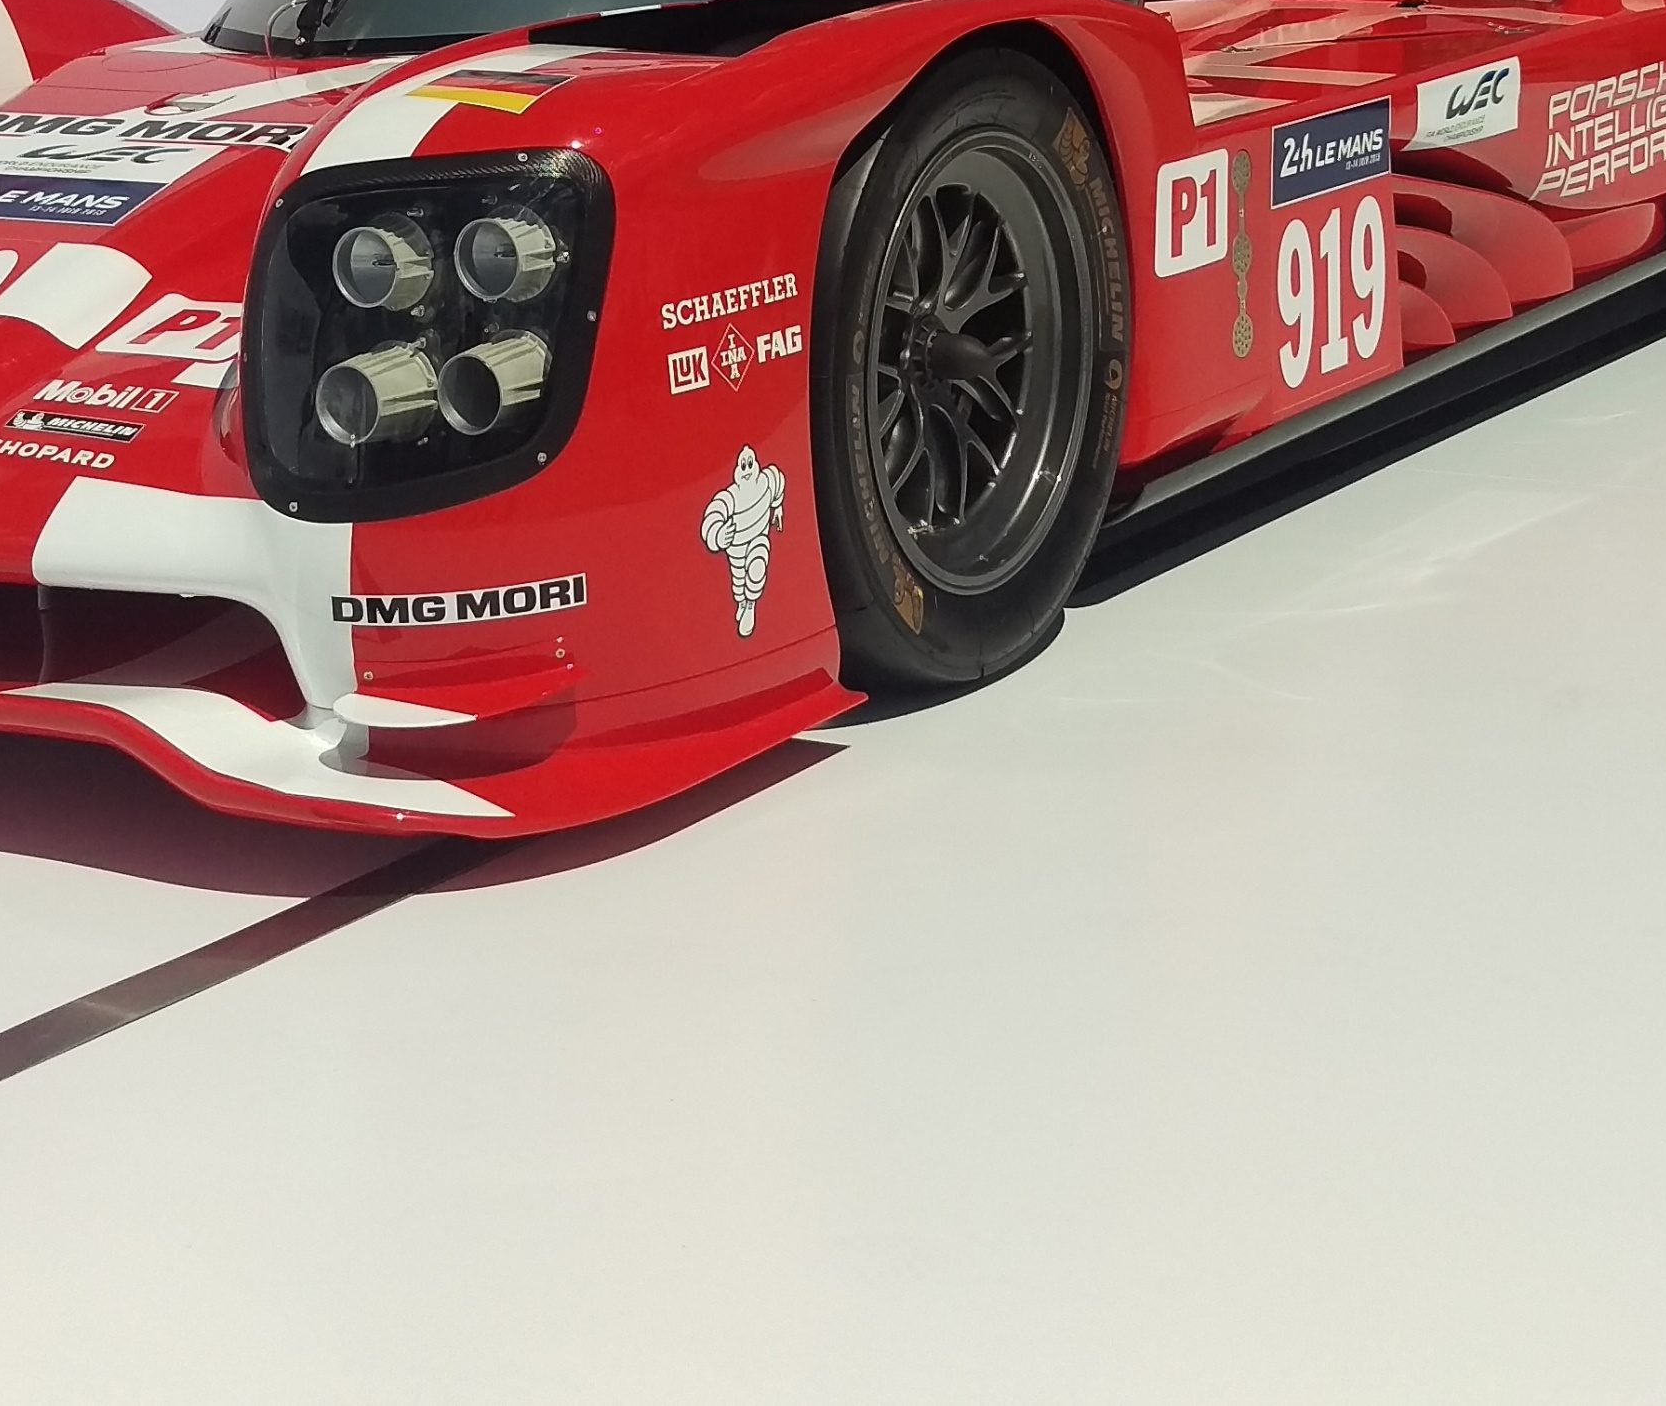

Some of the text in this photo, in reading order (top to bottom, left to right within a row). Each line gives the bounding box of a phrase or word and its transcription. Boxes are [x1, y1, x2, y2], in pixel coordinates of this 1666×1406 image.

[1446, 69, 1509, 120] WEC
[1315, 141, 1336, 168] LE
[1337, 128, 1384, 162] MANS
[20, 191, 132, 210] MANS
[1171, 168, 1219, 258] P1
[1090, 175, 1125, 343] MICHELIN
[661, 273, 798, 330] SCHAEFFLER
[1276, 195, 1387, 389] 919
[127, 309, 242, 350] P1
[757, 325, 803, 364] FAG
[34, 379, 144, 411] Mobil
[46, 416, 139, 438] MICHELIN
[334, 577, 584, 625] DMG MORI
